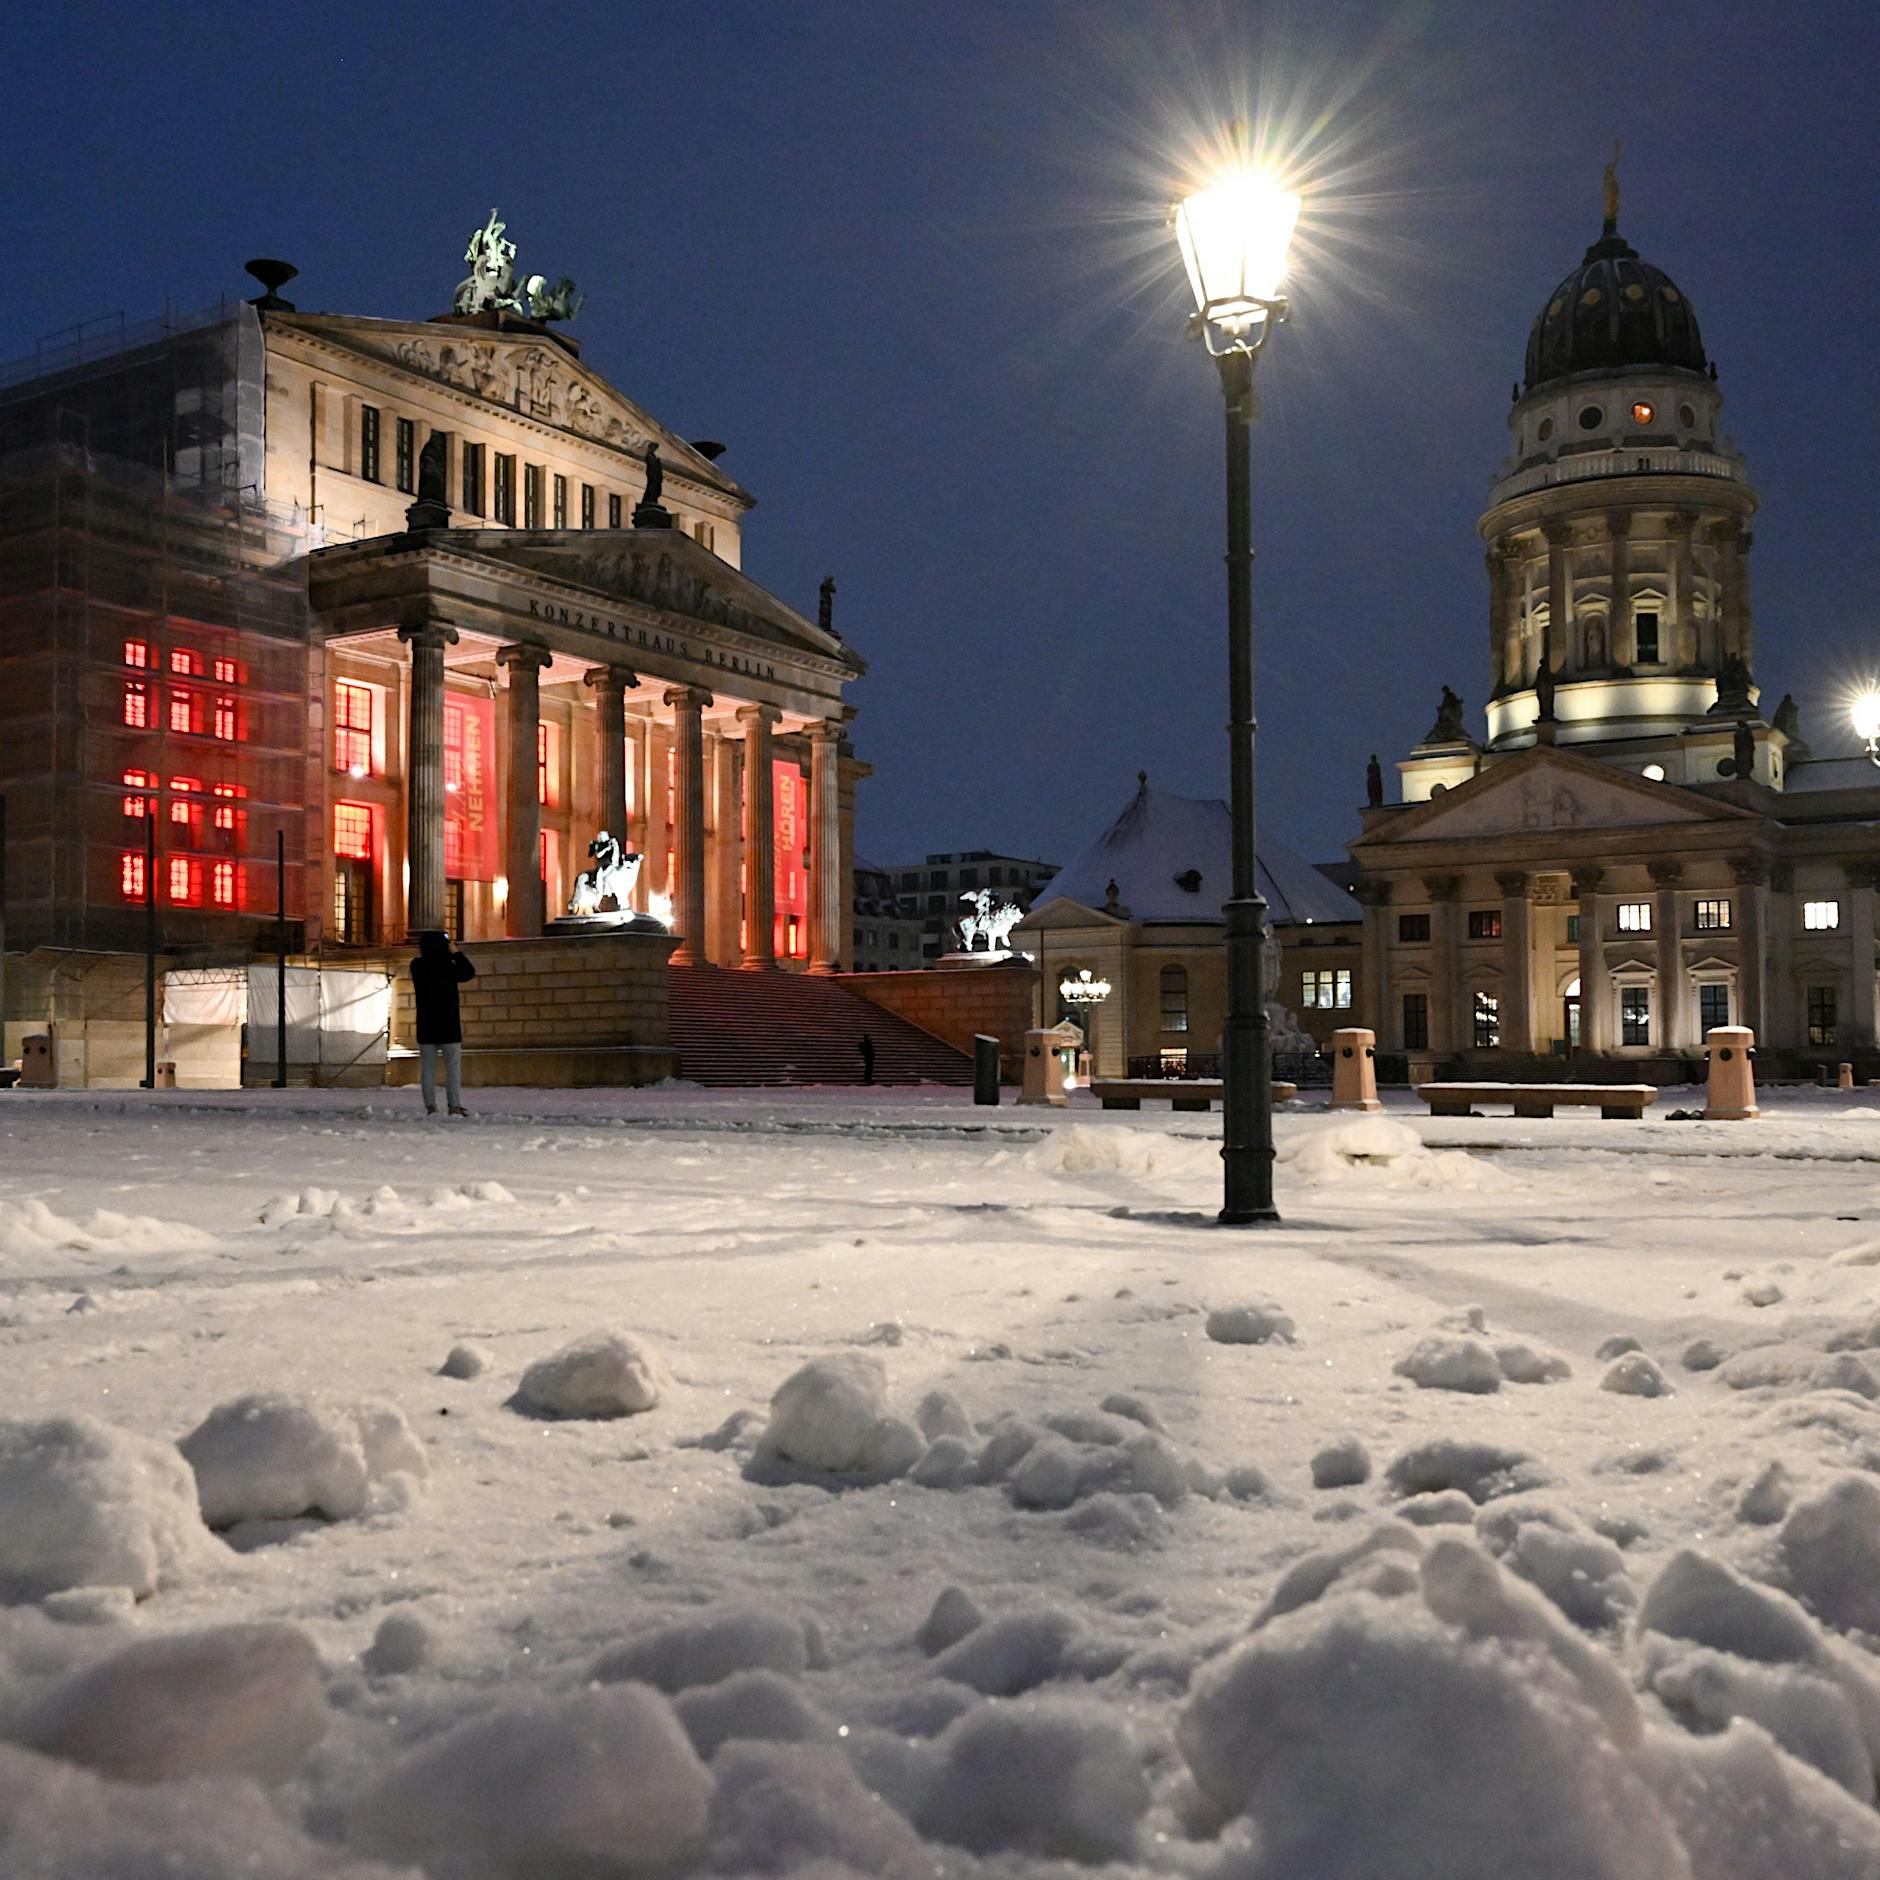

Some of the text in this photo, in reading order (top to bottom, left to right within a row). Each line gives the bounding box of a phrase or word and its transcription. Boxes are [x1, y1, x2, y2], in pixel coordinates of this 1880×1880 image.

[529, 599, 775, 679] KONZERTHAUS BERLIN
[465, 715, 484, 832] NEHMEN
[779, 775, 793, 851] HÖREN
